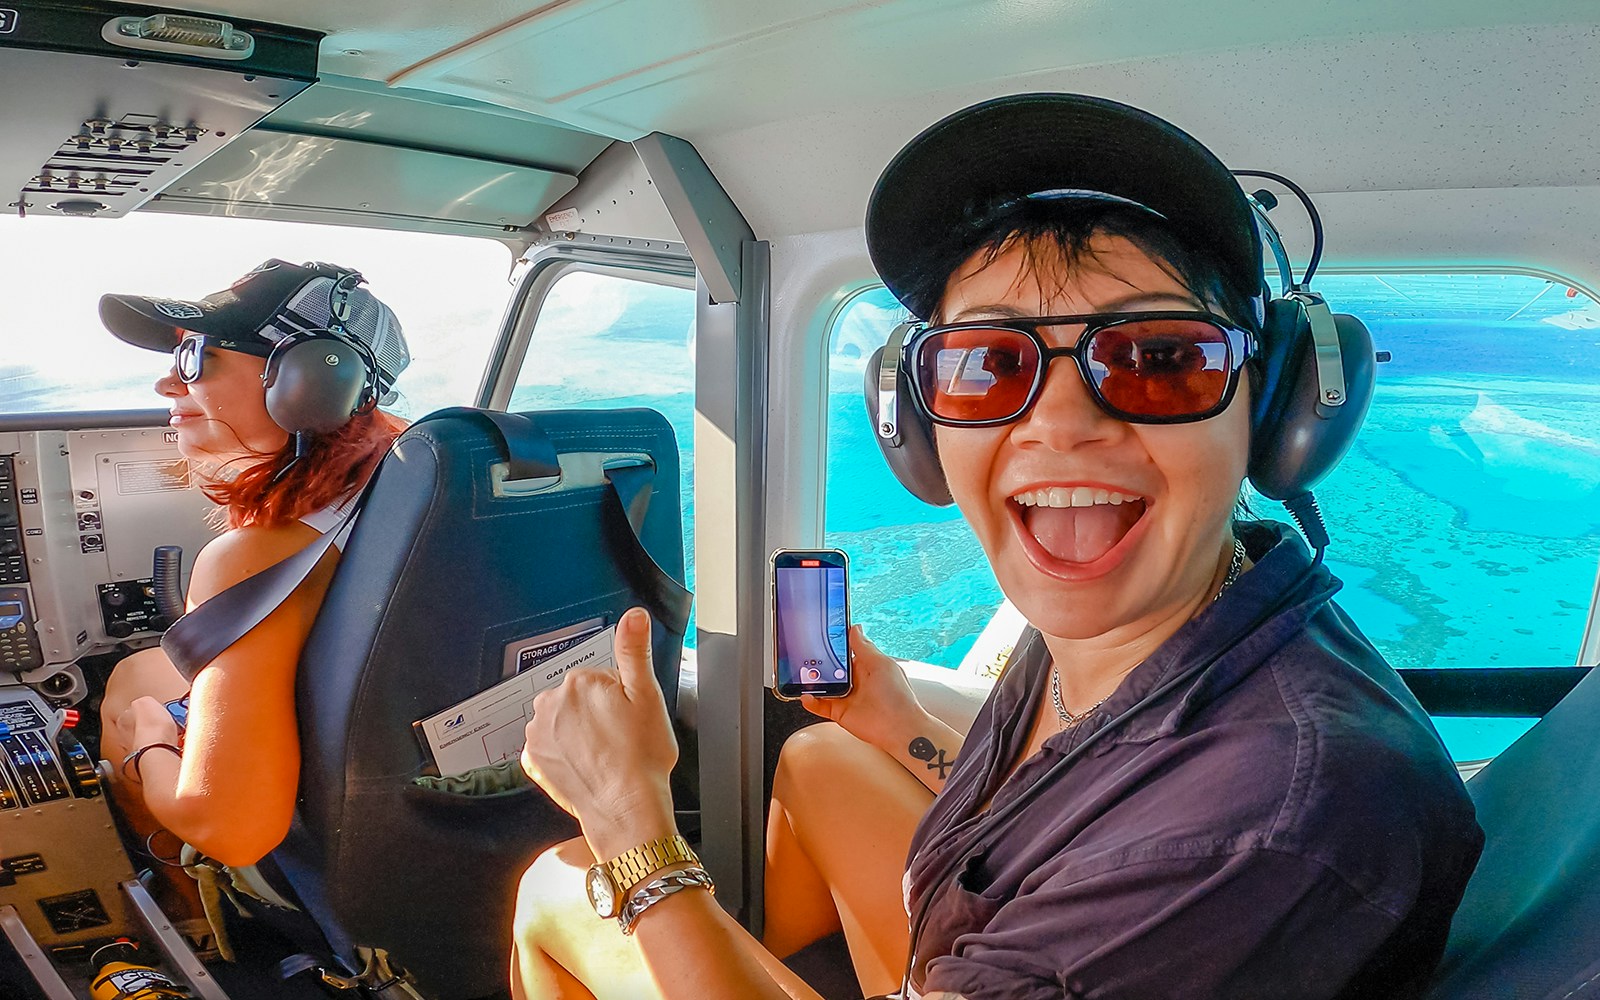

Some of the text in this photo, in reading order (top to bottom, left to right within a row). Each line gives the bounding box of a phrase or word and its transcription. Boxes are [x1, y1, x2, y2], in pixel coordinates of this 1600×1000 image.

[522, 644, 558, 661] STORAGE
[558, 641, 570, 650] OF
[565, 651, 595, 671] AIRVAN
